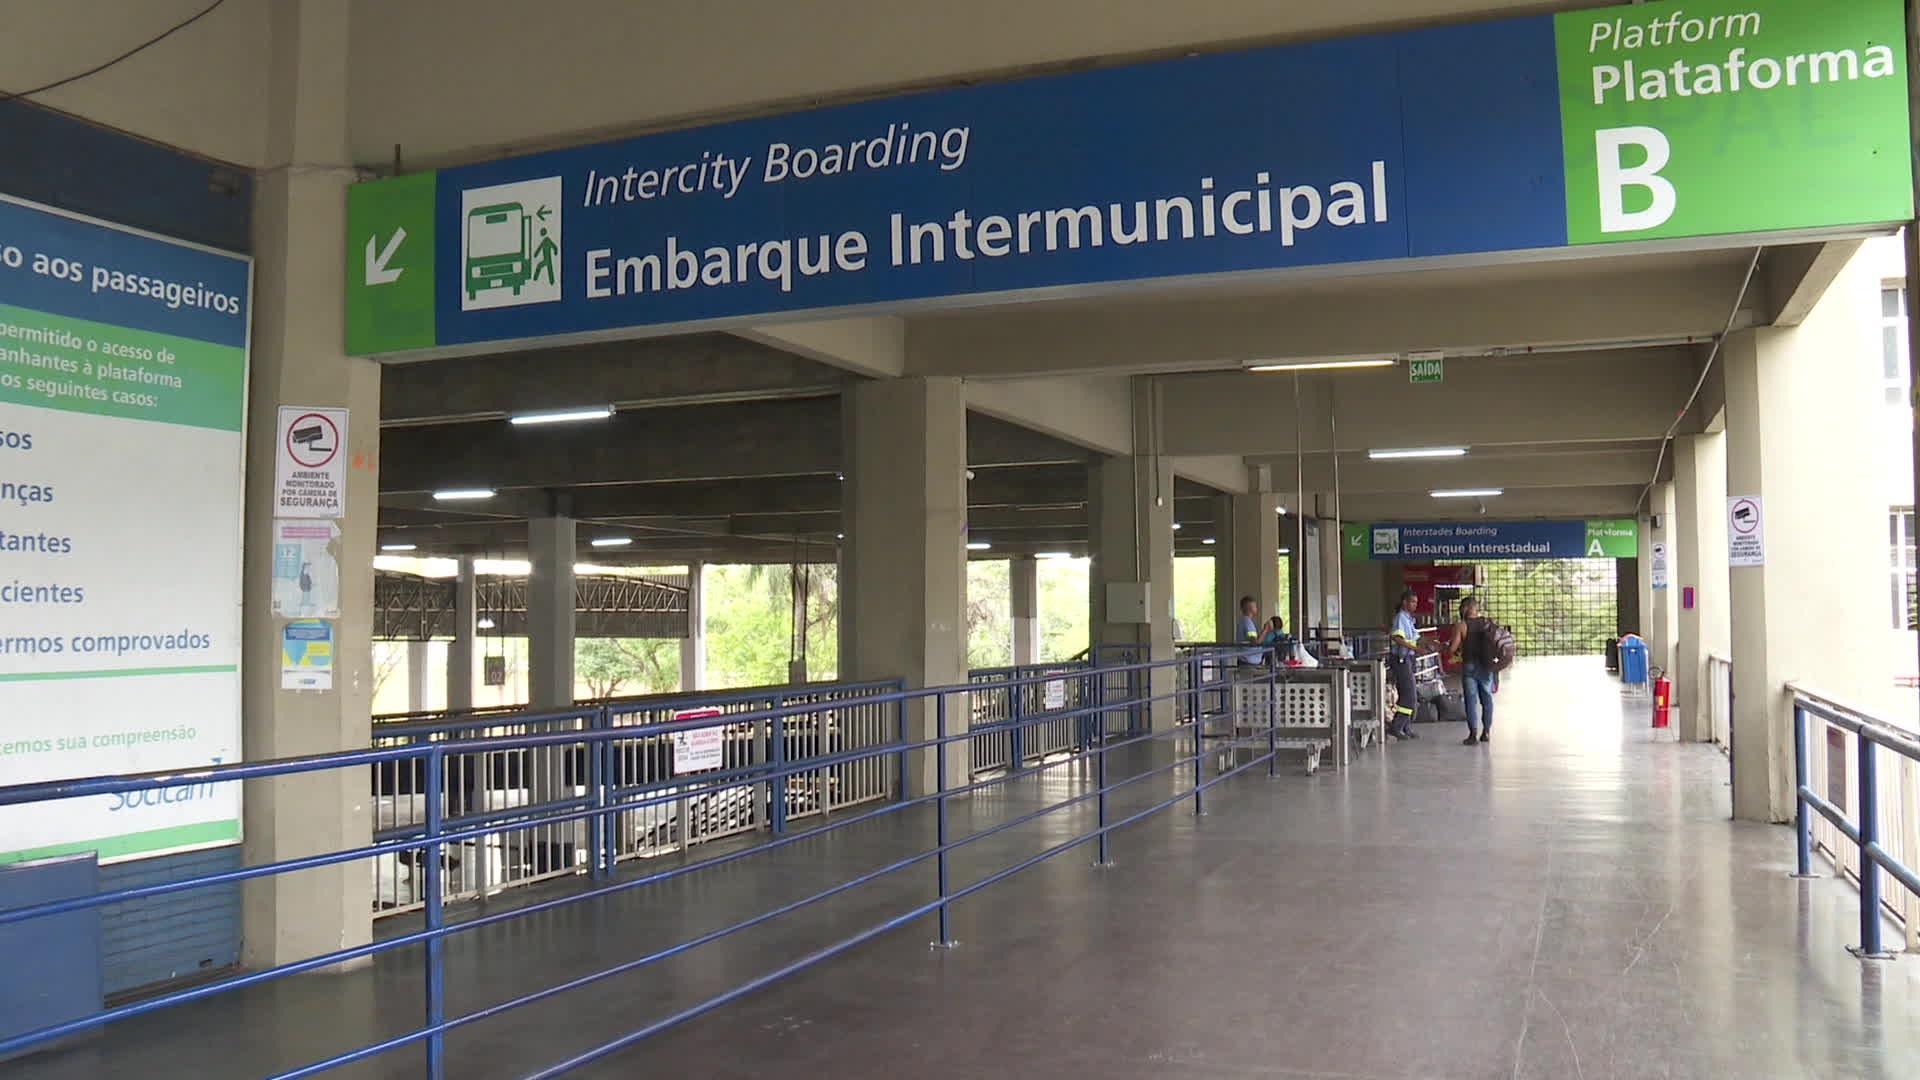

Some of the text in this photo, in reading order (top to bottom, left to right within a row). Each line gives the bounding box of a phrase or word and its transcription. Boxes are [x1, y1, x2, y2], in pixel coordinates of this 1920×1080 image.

[1588, 11, 1761, 53] Platform
[1592, 45, 1895, 104] Plataforma
[582, 121, 970, 207] Intercity Boarding
[1595, 126, 1676, 233] B
[585, 160, 1388, 298] Embarque Intermunicipal
[0, 244, 240, 314] o aos passageiros
[87, 338, 98, 352] o
[102, 342, 153, 361] acesso
[157, 346, 176, 364] de
[83, 359, 92, 375] à
[97, 362, 183, 389] plataforma
[1411, 360, 1441, 376] SAÍDA
[27, 377, 108, 401] seguintes
[113, 390, 159, 408] casos:
[286, 480, 335, 489] MONITORADO
[291, 471, 330, 480] AMBIENTE
[1, 482, 53, 506] nças
[280, 496, 339, 509] SEGURANÇA
[1455, 526, 1497, 537] Boarding
[1404, 540, 1551, 556] Embarque Interestadual
[1588, 538, 1604, 556] A
[1, 579, 84, 603] cientes
[0, 628, 210, 657] rmos comprovados
[0, 724, 197, 756] emos sua compreensão
